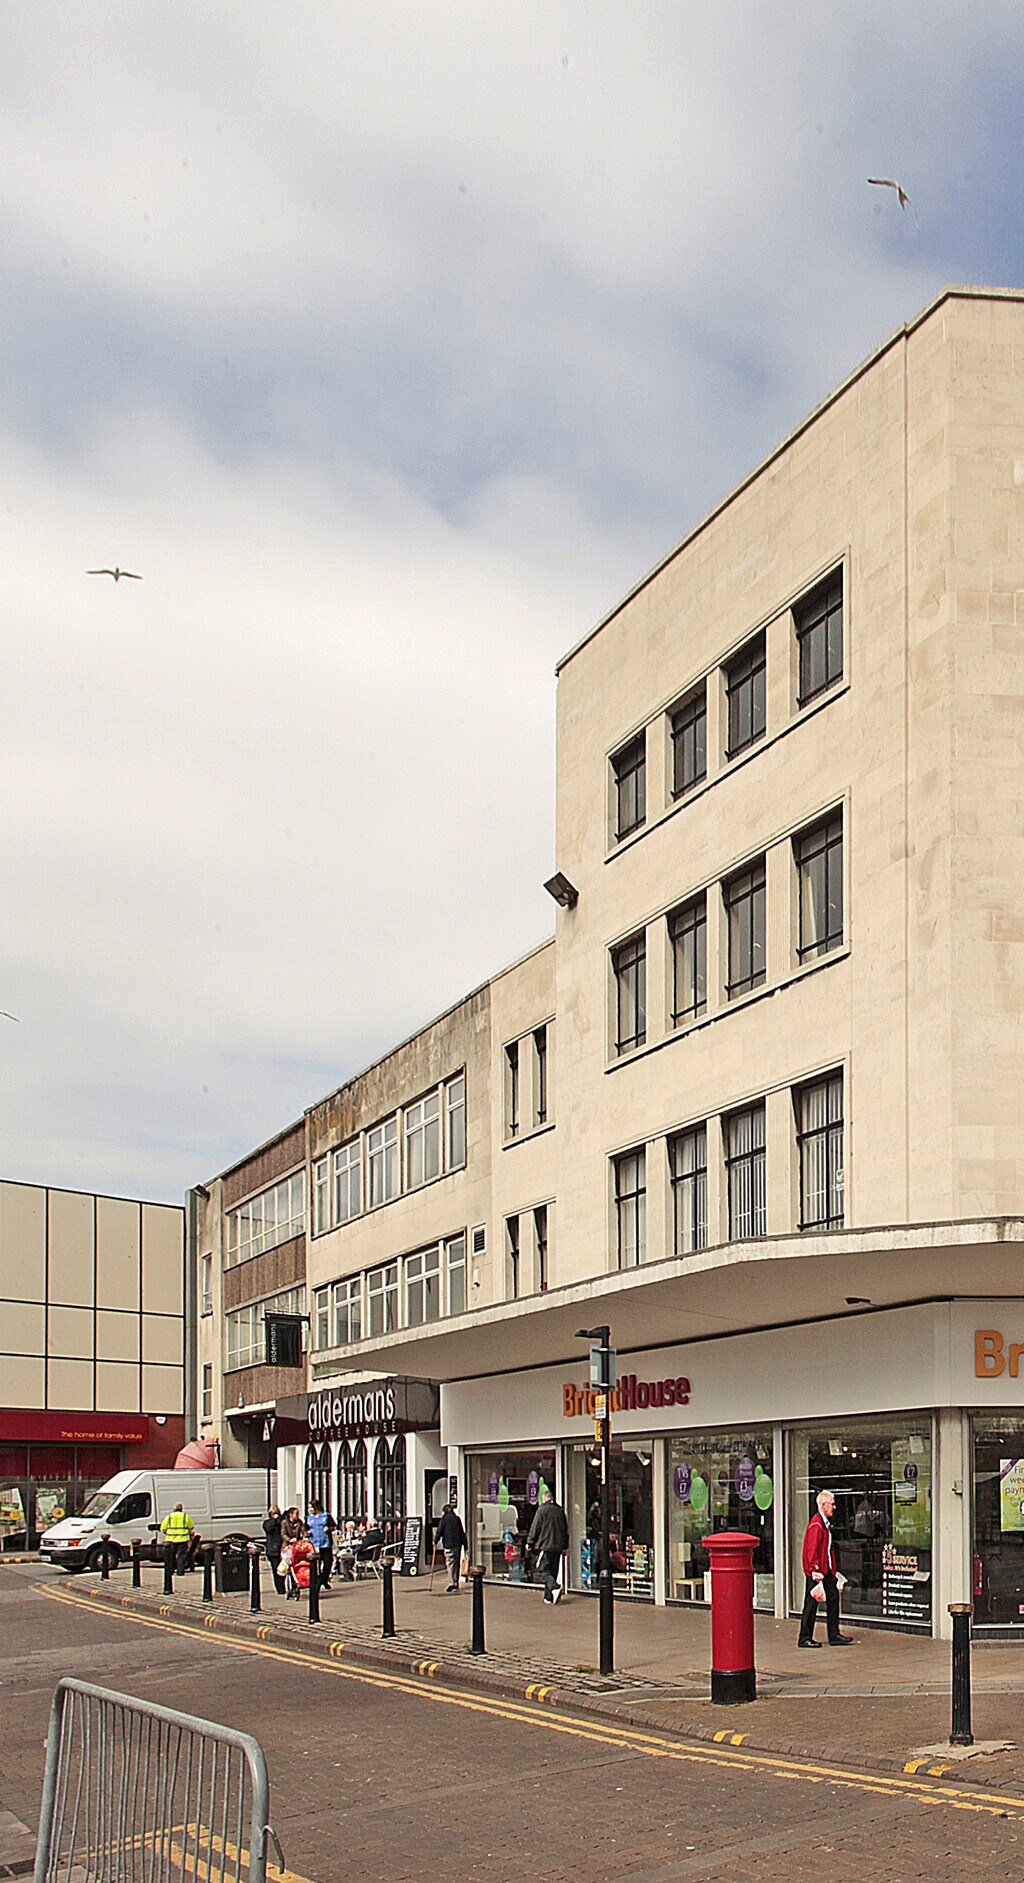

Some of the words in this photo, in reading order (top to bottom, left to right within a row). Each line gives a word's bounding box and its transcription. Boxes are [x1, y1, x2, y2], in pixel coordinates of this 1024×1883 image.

[308, 1388, 395, 1430] aldermans
[309, 1428, 349, 1441] COFFEE
[356, 1421, 396, 1436] HOUSE
[893, 1555, 918, 1565] SERVICE
